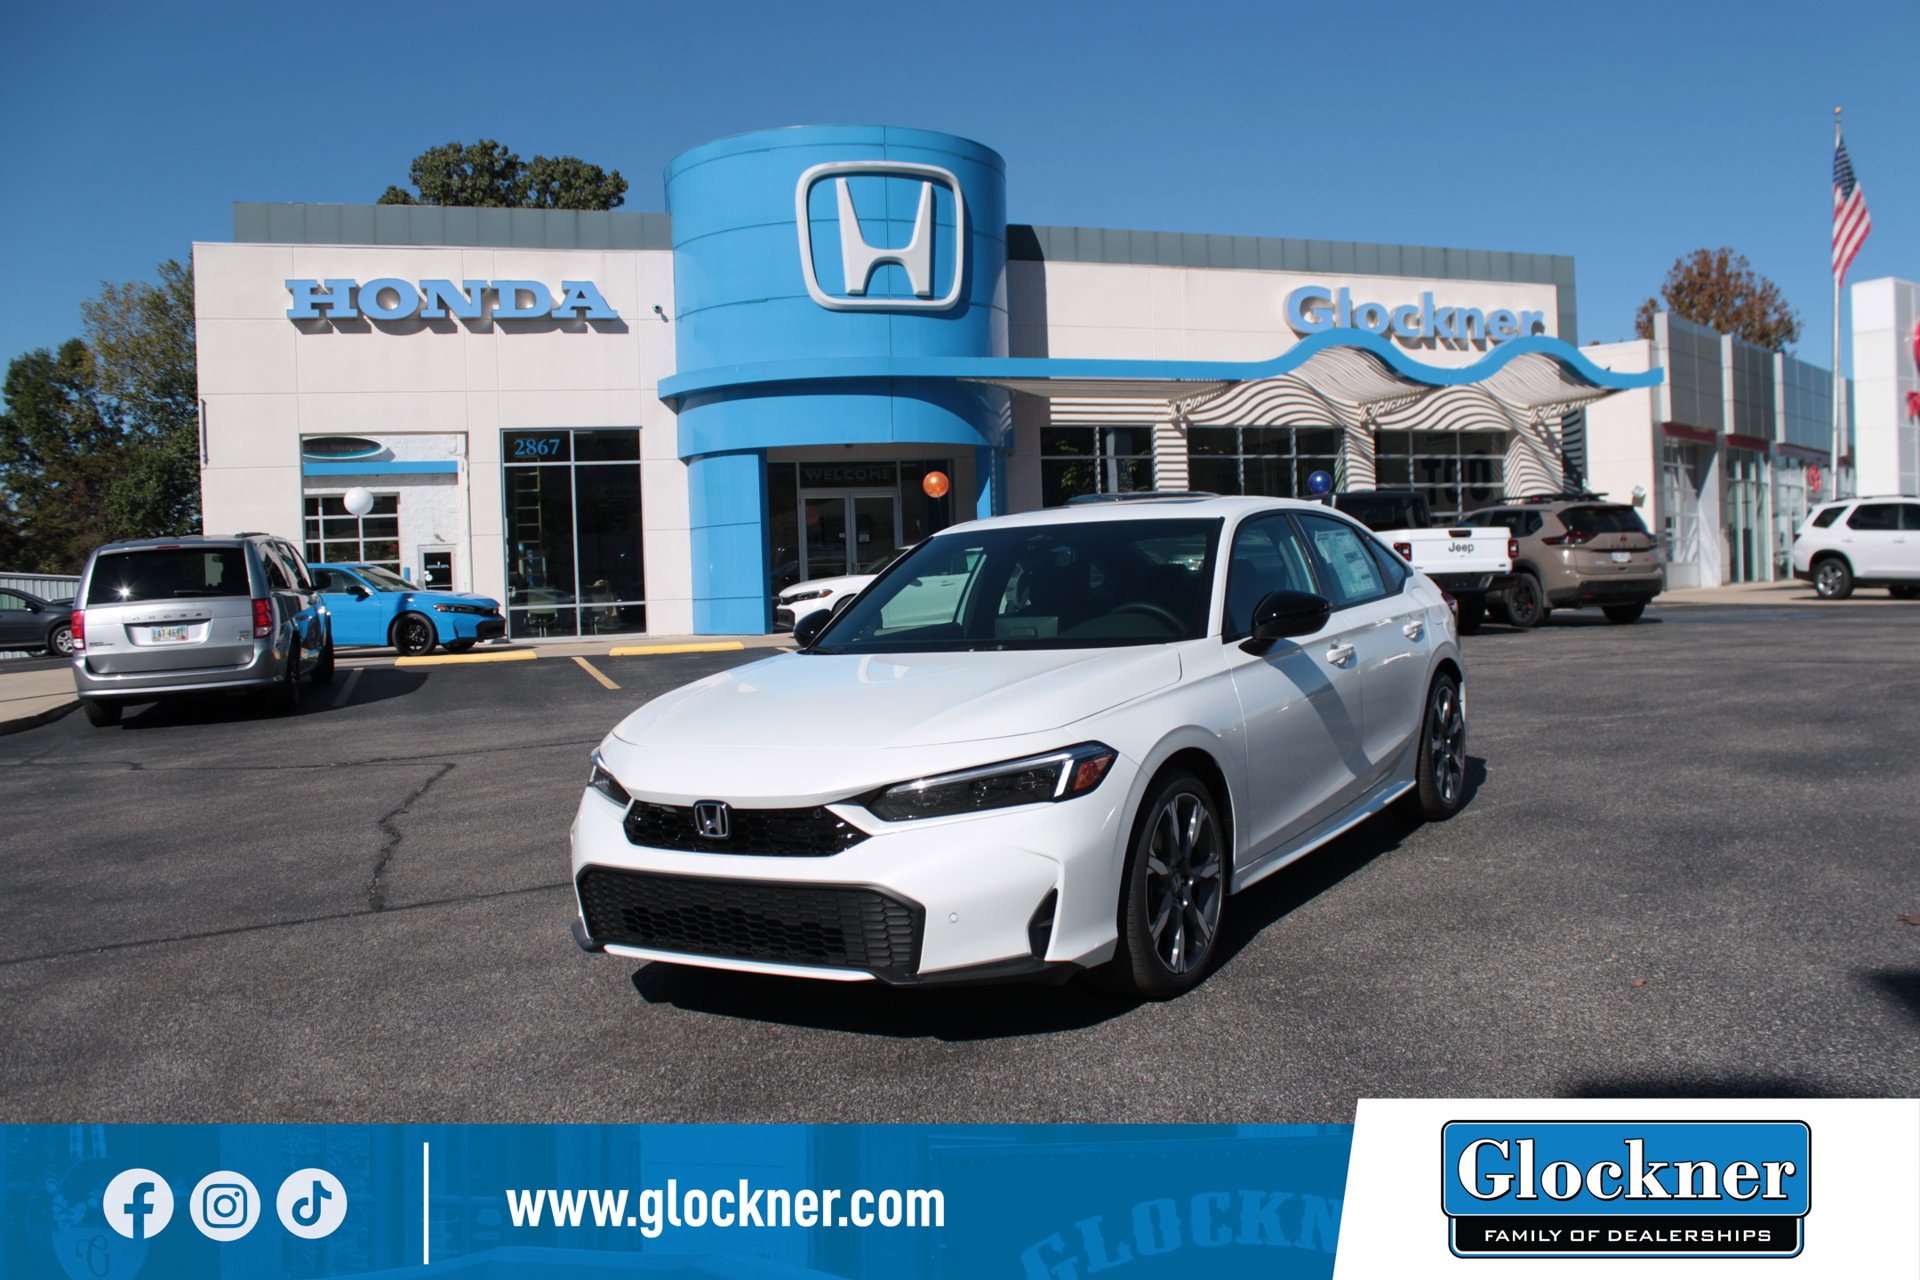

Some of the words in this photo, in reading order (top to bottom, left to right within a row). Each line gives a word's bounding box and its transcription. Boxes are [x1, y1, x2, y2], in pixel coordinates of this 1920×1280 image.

[285, 278, 618, 320] HONDA
[1286, 285, 1545, 341] Glockner
[514, 439, 560, 456] 2867
[805, 467, 892, 481] WELCOME
[1448, 542, 1475, 554] Jeep
